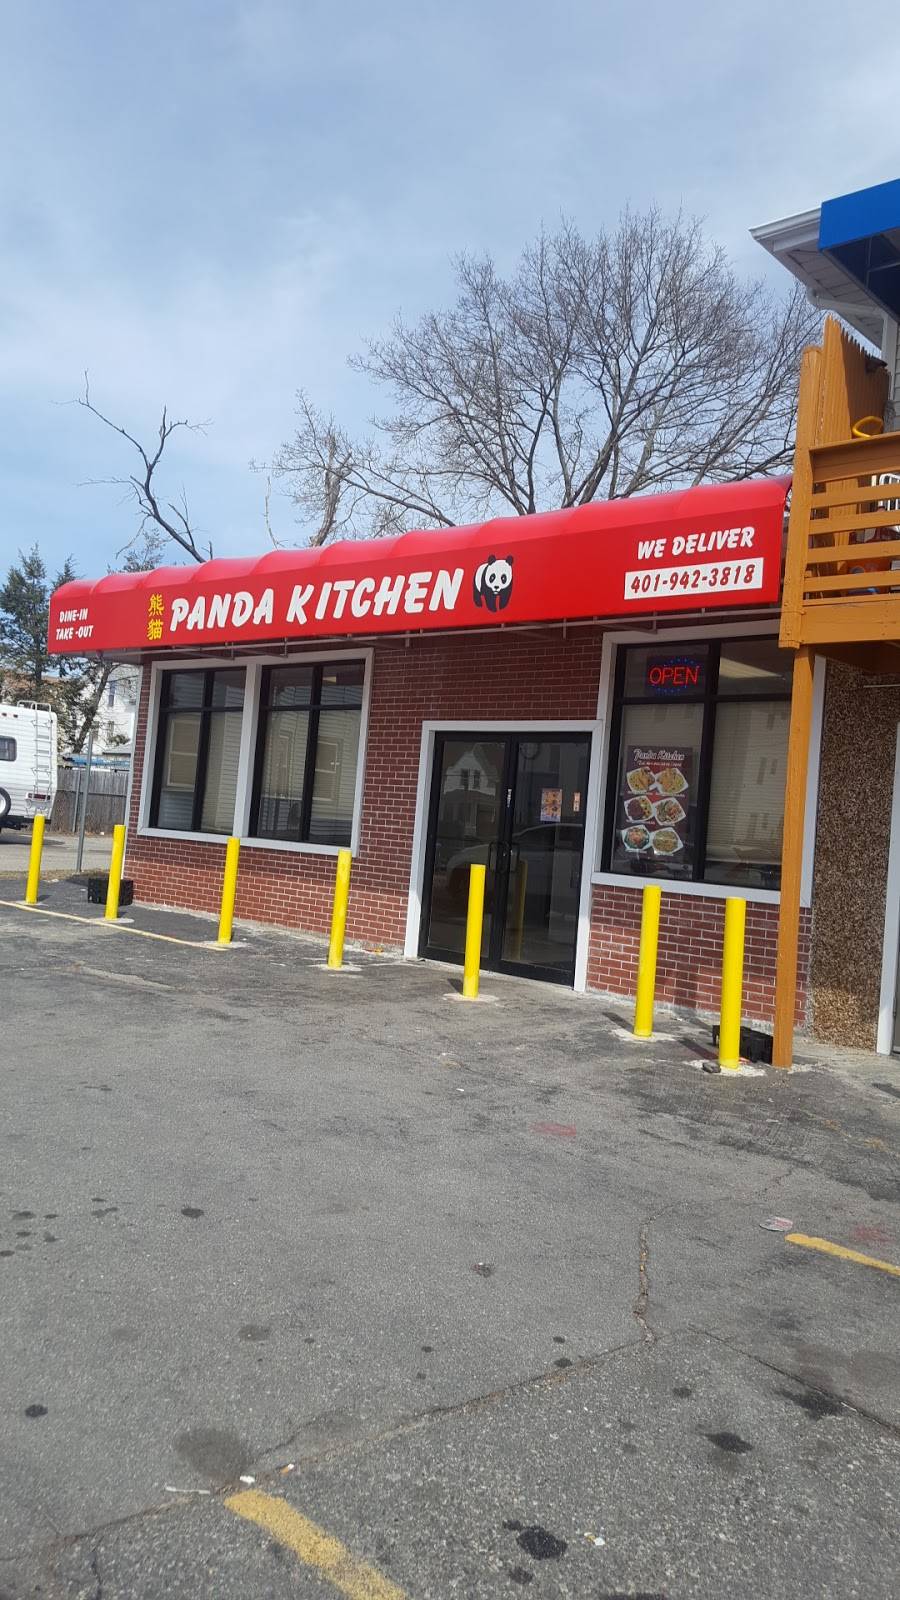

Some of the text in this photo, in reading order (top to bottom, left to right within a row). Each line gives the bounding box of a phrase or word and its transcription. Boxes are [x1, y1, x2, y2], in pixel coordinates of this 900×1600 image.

[637, 526, 755, 560] WE DELIVER
[630, 563, 756, 594] 401-942-3818
[59, 608, 89, 623] DINE-IN
[169, 568, 464, 632] PANDA KITCHEN
[147, 593, 164, 641] 熊貓
[56, 627, 74, 641] TAKE
[649, 665, 700, 686] OPEN
